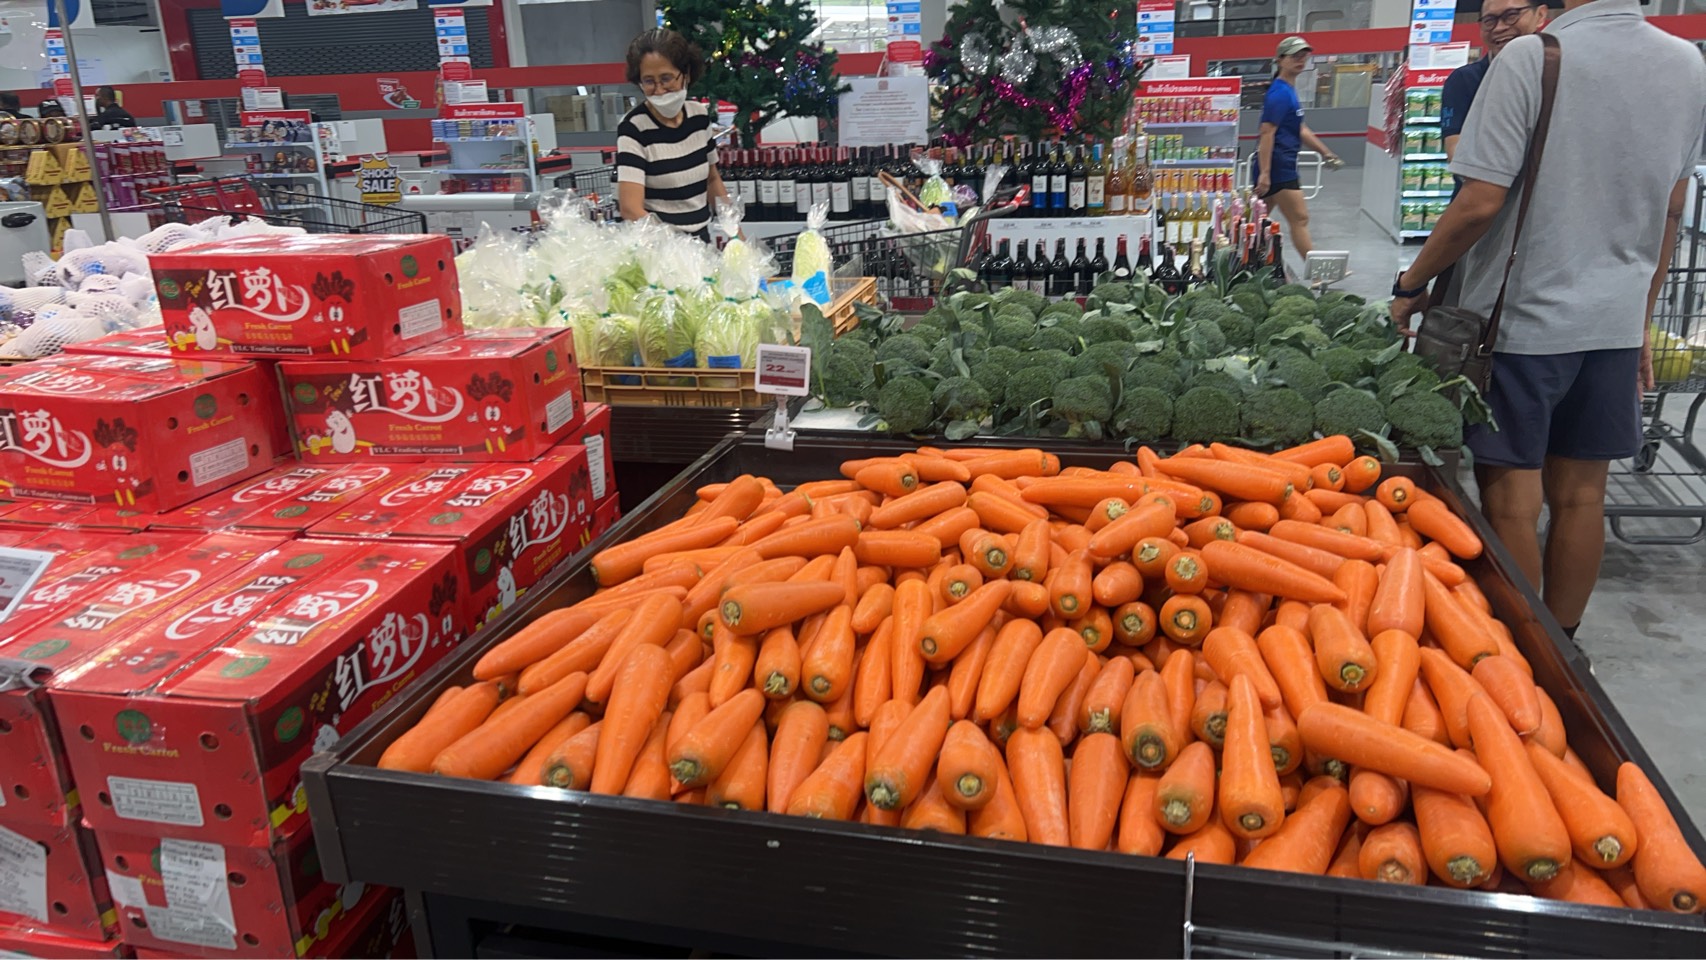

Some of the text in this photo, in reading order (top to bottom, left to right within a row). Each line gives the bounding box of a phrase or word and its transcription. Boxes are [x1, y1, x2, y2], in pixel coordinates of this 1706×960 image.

[362, 169, 396, 178] SHOCK
[362, 179, 396, 192] SALE
[206, 267, 310, 322] 红萝卜
[349, 369, 464, 423] 红萝卜
[388, 424, 413, 432] Fresh
[509, 489, 569, 560] 红萝卜
[334, 612, 429, 712] 红萝卜
[103, 743, 180, 757] Fresh Carrot
